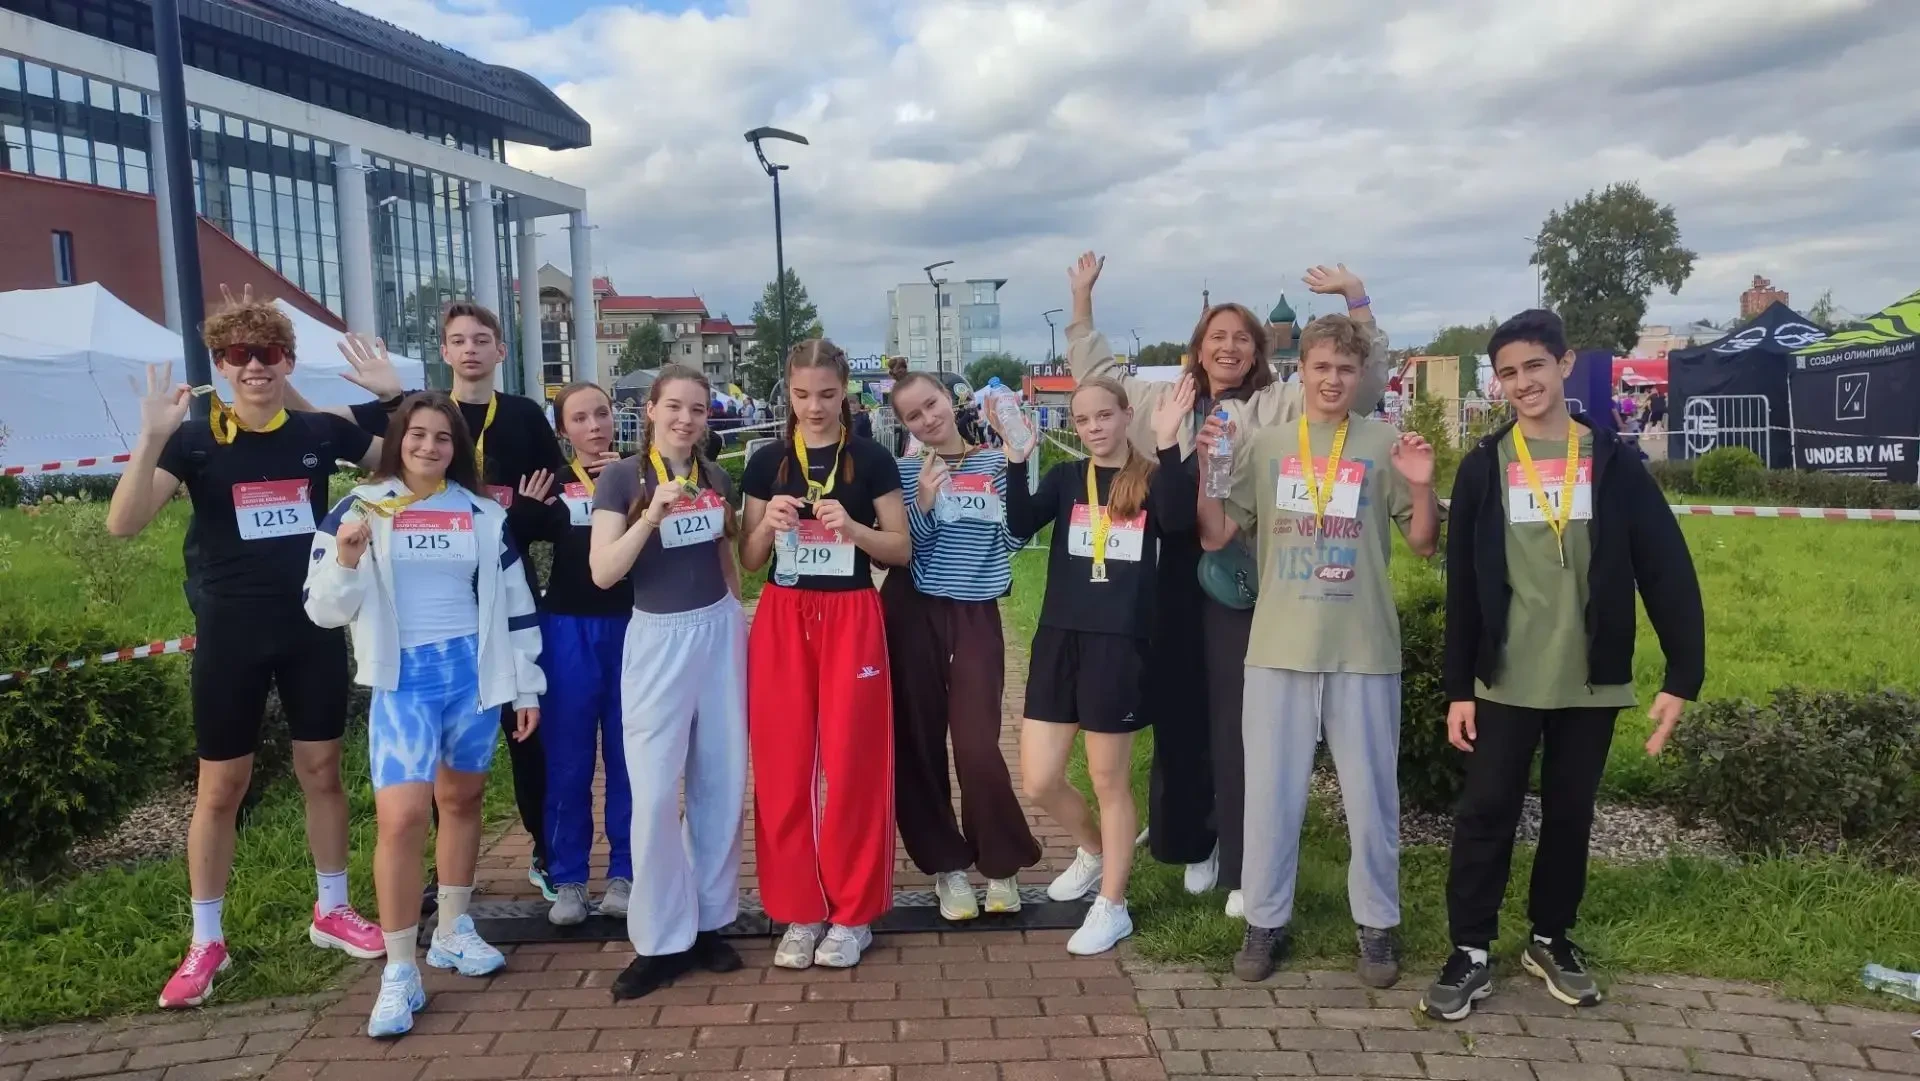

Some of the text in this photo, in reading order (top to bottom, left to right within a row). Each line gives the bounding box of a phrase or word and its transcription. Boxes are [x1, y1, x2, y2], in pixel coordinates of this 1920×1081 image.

[1810, 341, 1915, 366] СОЗДАН ОЛИМПИЙЦАМИ
[1804, 443, 1905, 465] UNDER BY ME
[252, 508, 299, 528] 1213
[674, 515, 711, 536] 1221
[405, 534, 450, 549] 1215
[798, 547, 831, 564] 219
[1319, 567, 1351, 580] ART
